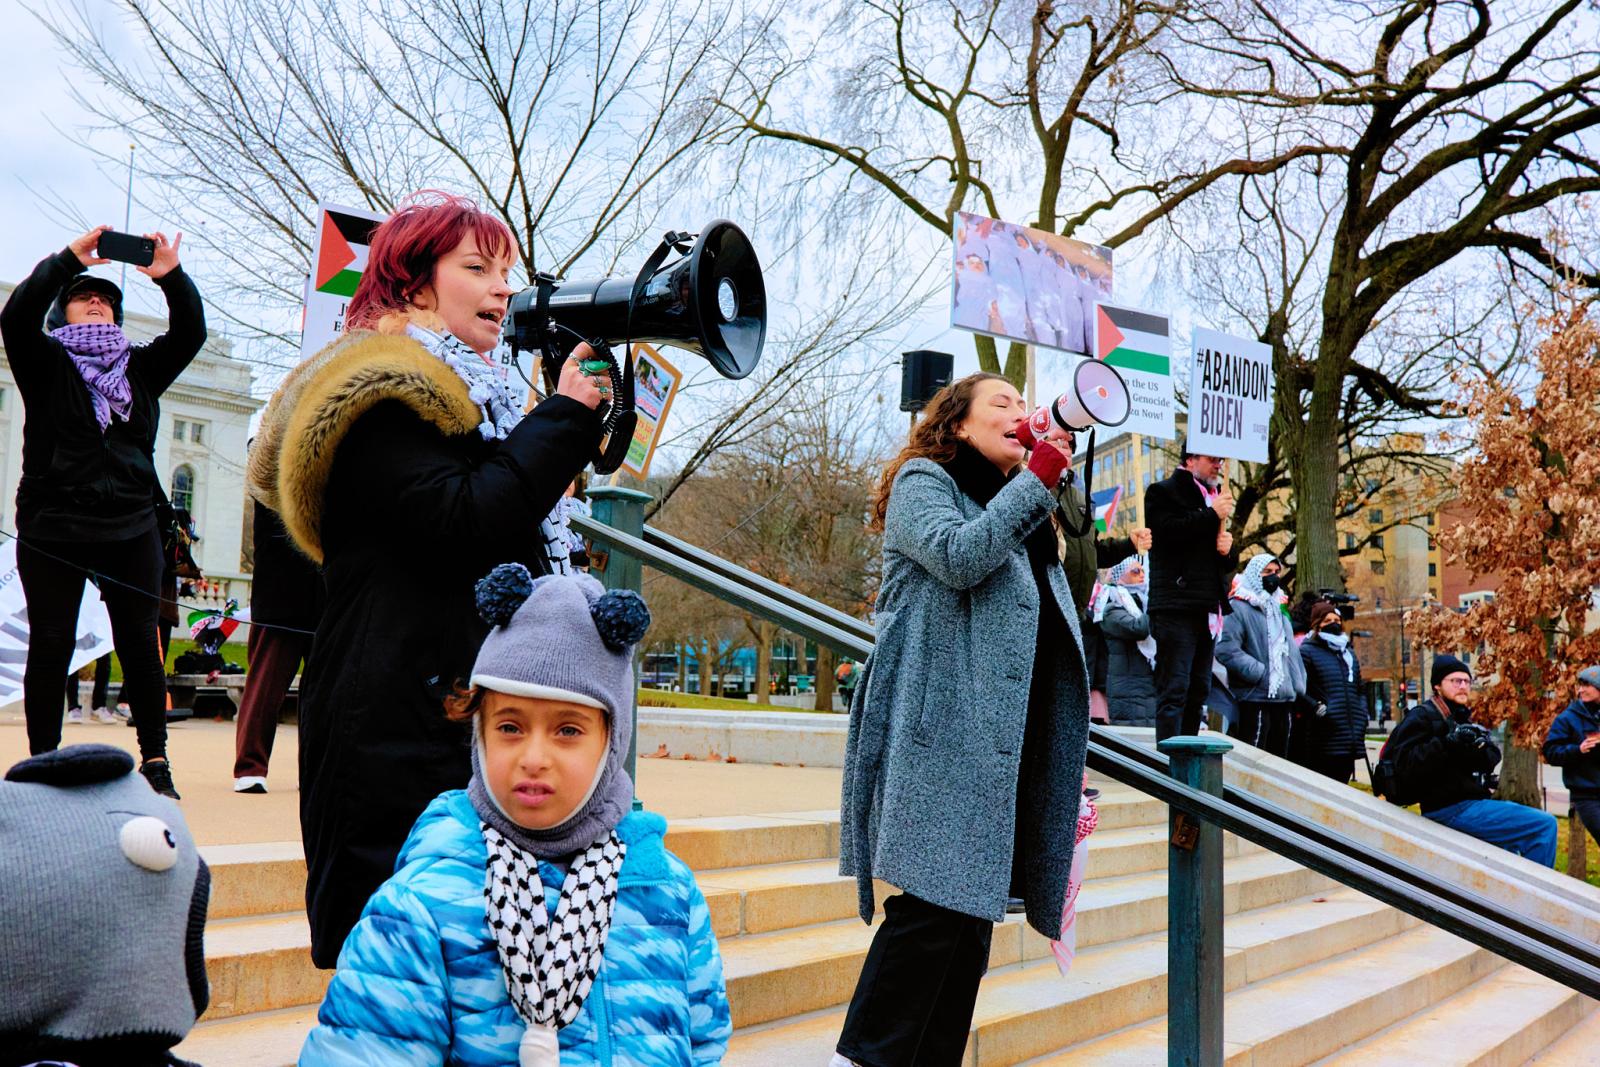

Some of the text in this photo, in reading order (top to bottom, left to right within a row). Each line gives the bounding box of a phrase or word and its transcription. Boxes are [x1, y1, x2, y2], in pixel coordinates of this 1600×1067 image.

[1197, 348, 1269, 403] #ABANDON
[1132, 378, 1146, 389] the
[1148, 381, 1159, 392] US
[1132, 393, 1171, 408] Genocide
[1142, 409, 1164, 421] Now!
[1200, 392, 1243, 440] BIDEN
